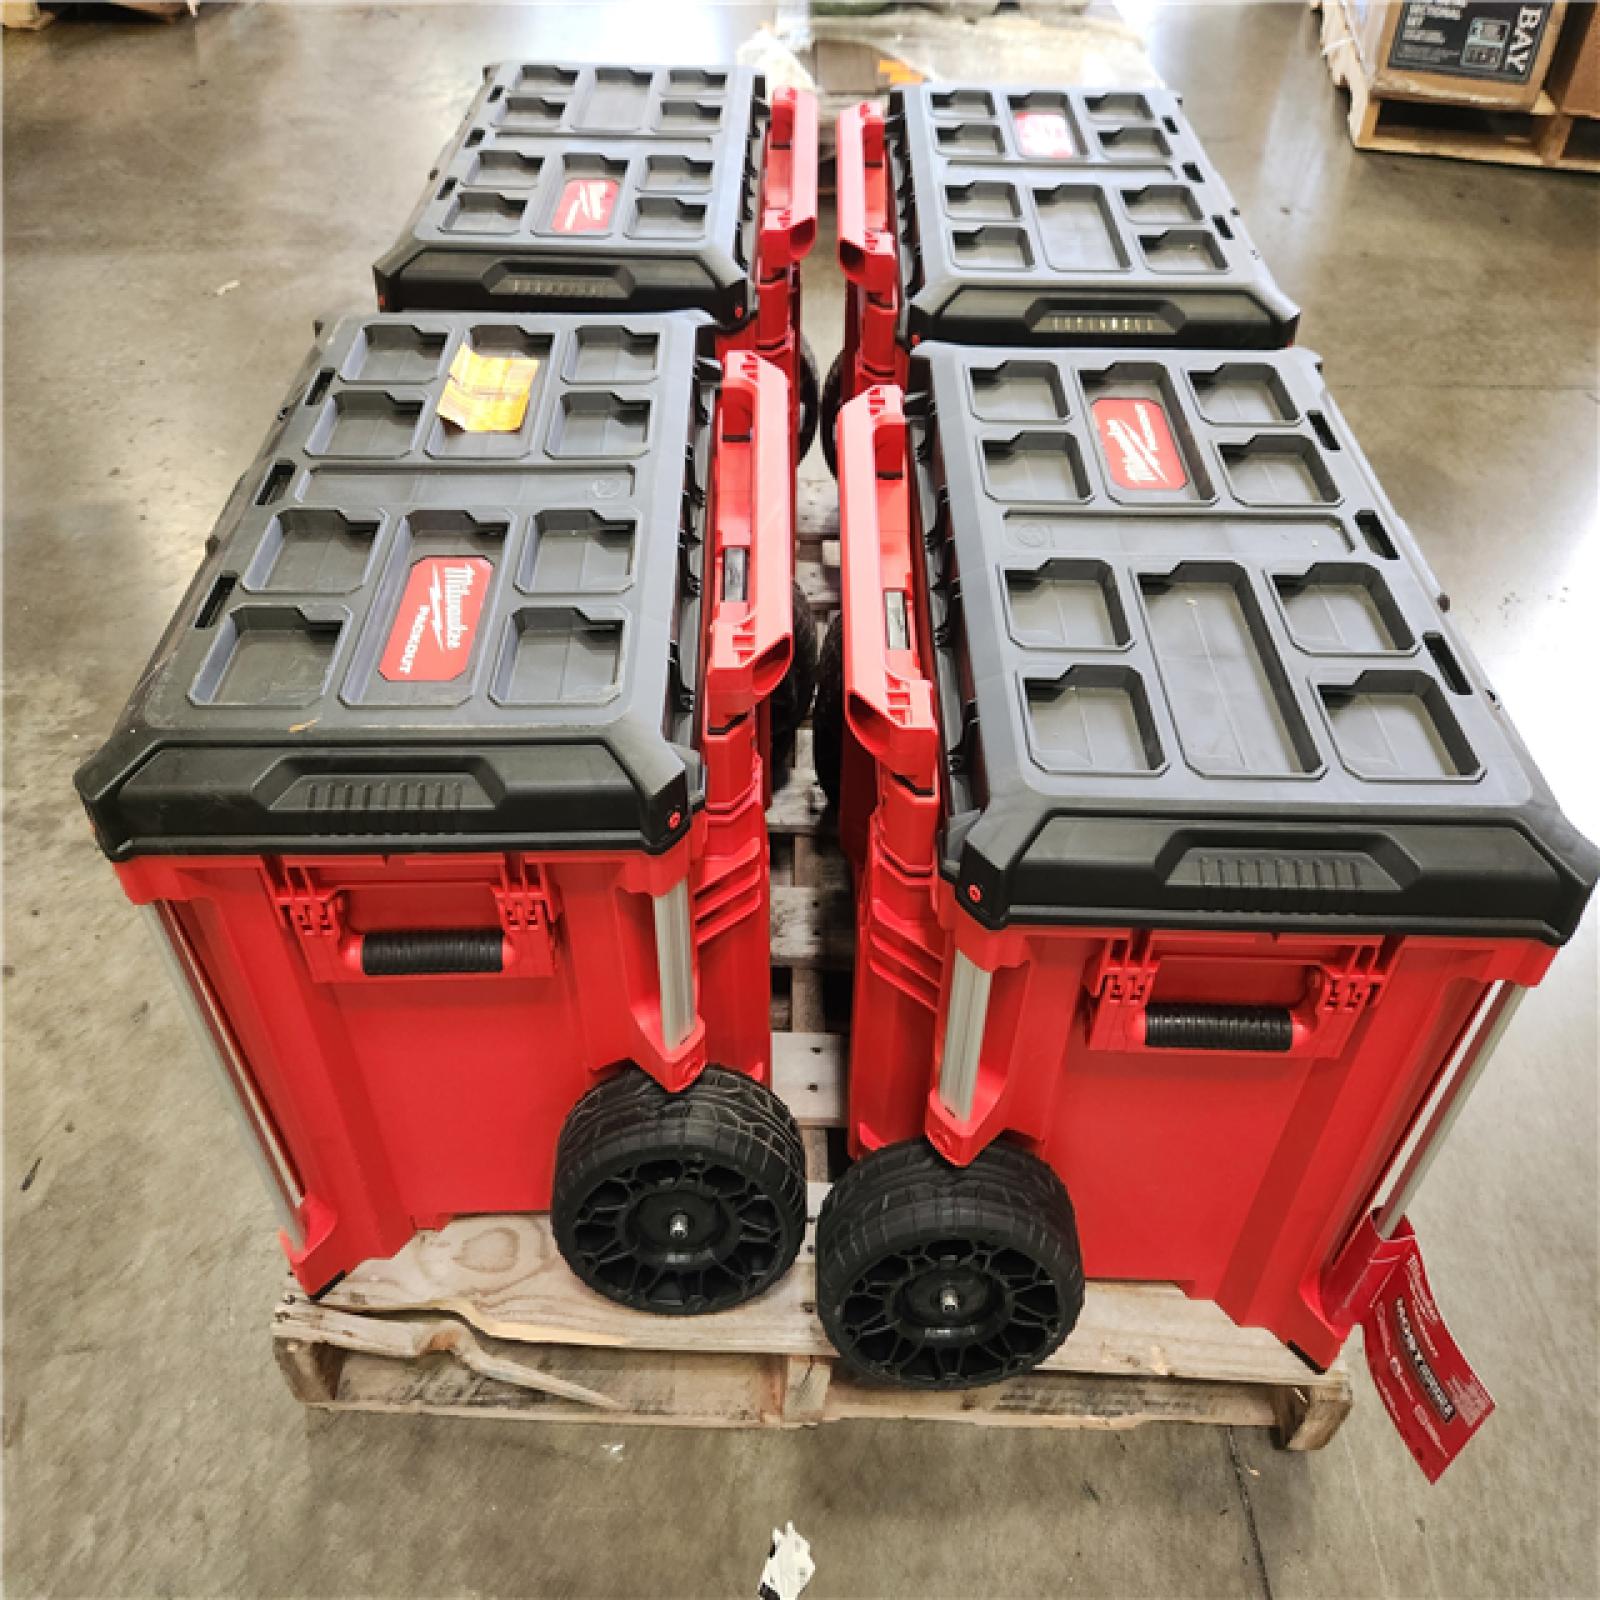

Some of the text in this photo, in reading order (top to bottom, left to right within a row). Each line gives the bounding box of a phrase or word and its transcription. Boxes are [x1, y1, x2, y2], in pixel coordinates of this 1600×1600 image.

[1506, 6, 1542, 73] BAY
[399, 604, 430, 674] PACKOUT
[443, 562, 475, 649] Milwaukee
